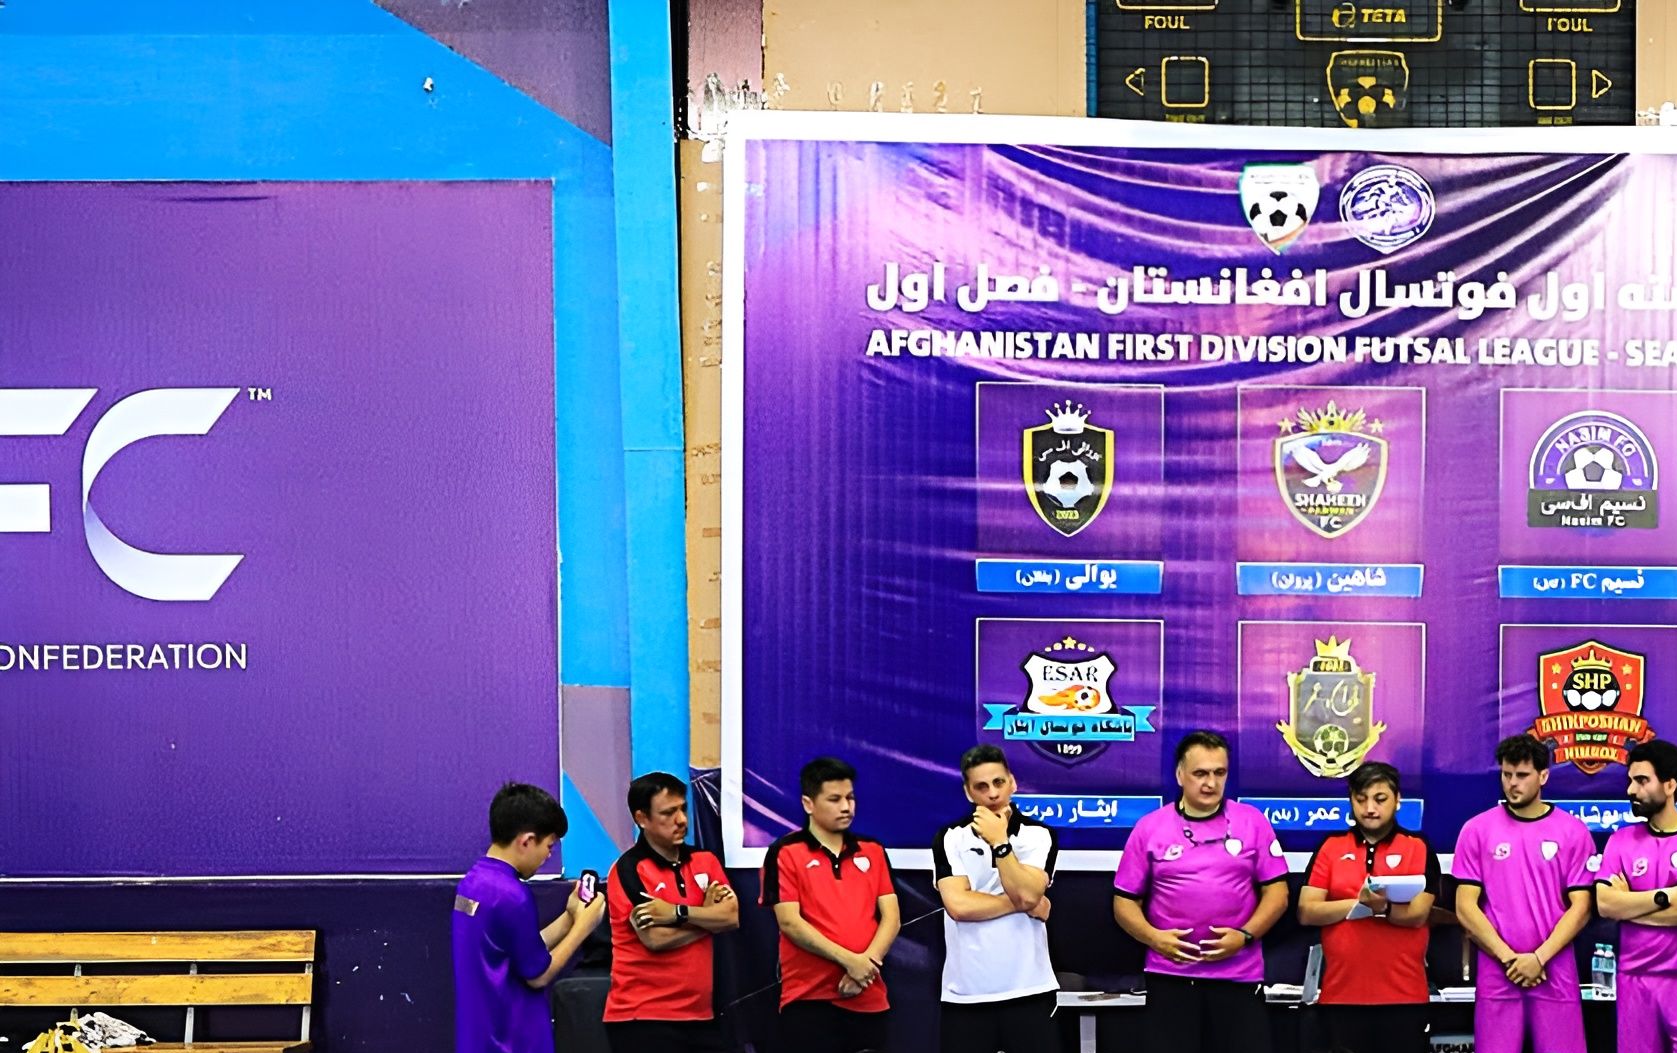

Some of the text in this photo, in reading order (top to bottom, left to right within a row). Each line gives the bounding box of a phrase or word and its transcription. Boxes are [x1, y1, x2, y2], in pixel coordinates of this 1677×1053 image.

[1144, 15, 1191, 30] FOUL
[1361, 8, 1406, 23] TETA
[866, 261, 945, 313] اول
[957, 262, 1059, 313] فصل
[1097, 265, 1327, 315] افغانستان
[1339, 268, 1516, 320] فوتسال
[1527, 270, 1605, 321] اول
[866, 329, 1100, 359] AFGHANISTAN
[1107, 333, 1193, 361] FIRST
[1199, 335, 1347, 362] DIVISION
[1354, 336, 1470, 365] FUTSAL
[1478, 338, 1600, 367] LEAGUE
[248, 387, 272, 401] TM
[1600, 496, 1646, 516] نسیم
[1327, 567, 1387, 592] شاهین
[1571, 573, 1597, 588] FC
[1601, 569, 1645, 594] نسیم
[1043, 665, 1099, 682] ESAR
[1572, 673, 1612, 690] SHP
[1068, 800, 1118, 823] ایثار
[1305, 806, 1340, 826] عمر
